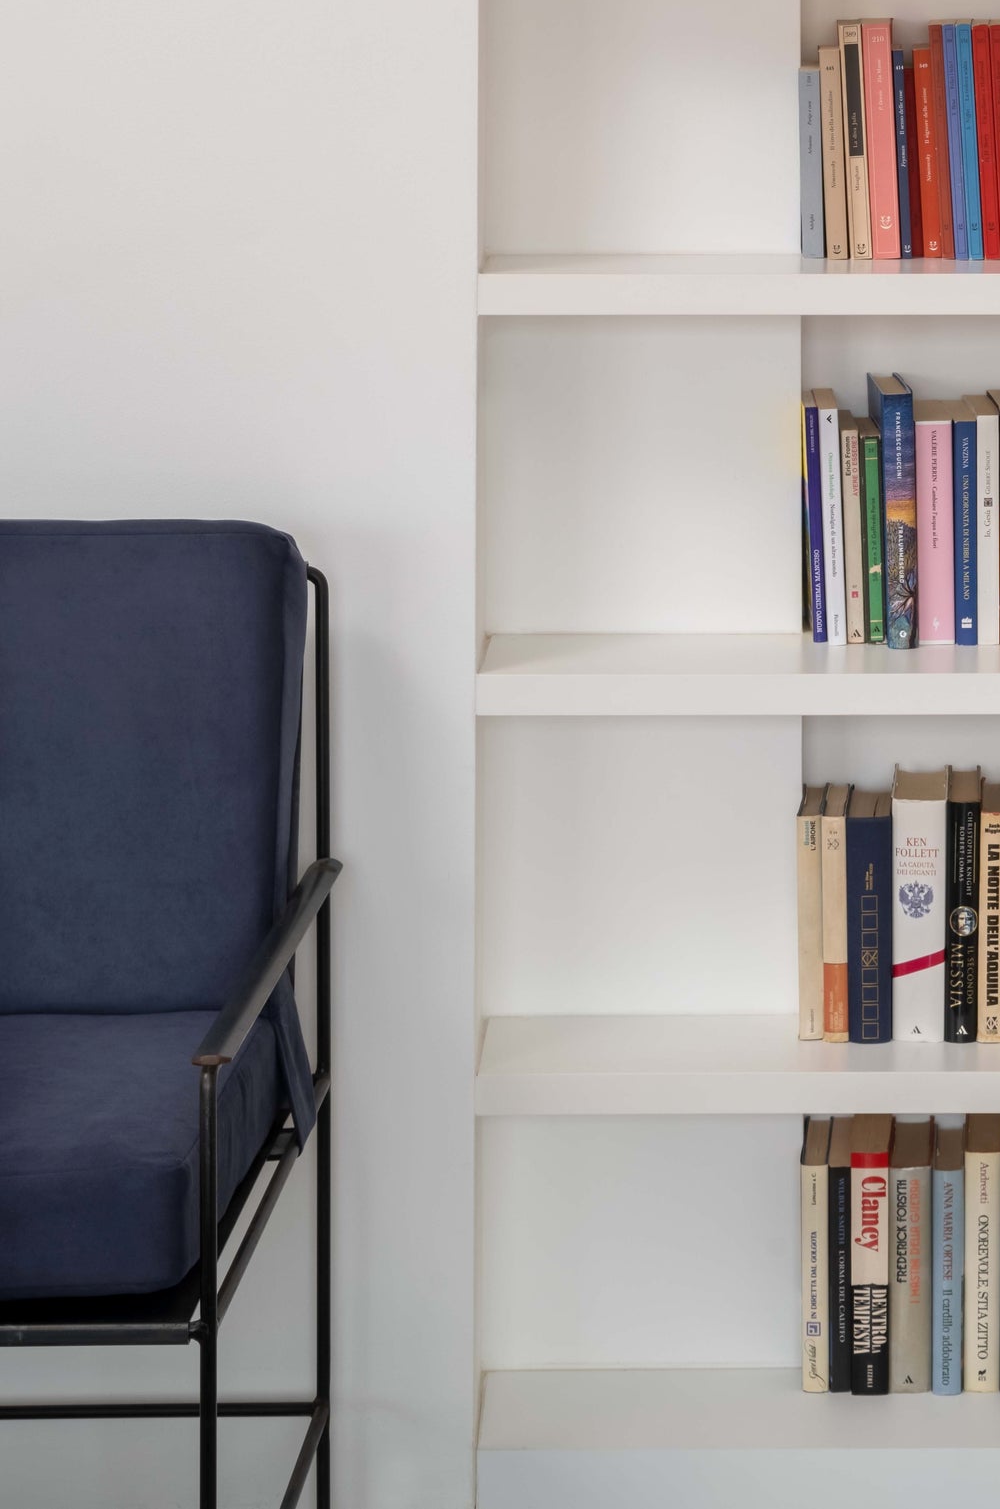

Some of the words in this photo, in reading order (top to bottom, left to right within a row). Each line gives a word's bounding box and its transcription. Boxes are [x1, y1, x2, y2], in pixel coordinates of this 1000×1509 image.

[895, 848, 938, 858] FOLLETT
[906, 837, 926, 846] KEN
[988, 844, 1000, 862] LA
[988, 866, 1000, 910] NOTTE
[951, 944, 963, 1008] MESSIA
[987, 916, 999, 1007] DELL'AQUILA
[896, 1180, 906, 1224] FORSYTH
[944, 1182, 953, 1211] ANNA
[980, 1162, 989, 1203] Andreotti
[855, 1176, 886, 1252] Clancy
[943, 1212, 952, 1242] MARIA
[897, 1226, 907, 1285] FREDERICK
[942, 1243, 952, 1281] ORTESE
[853, 1288, 871, 1354] TEMPESTA
[978, 1292, 988, 1320] STIA
[977, 1322, 988, 1360] ZITTO
